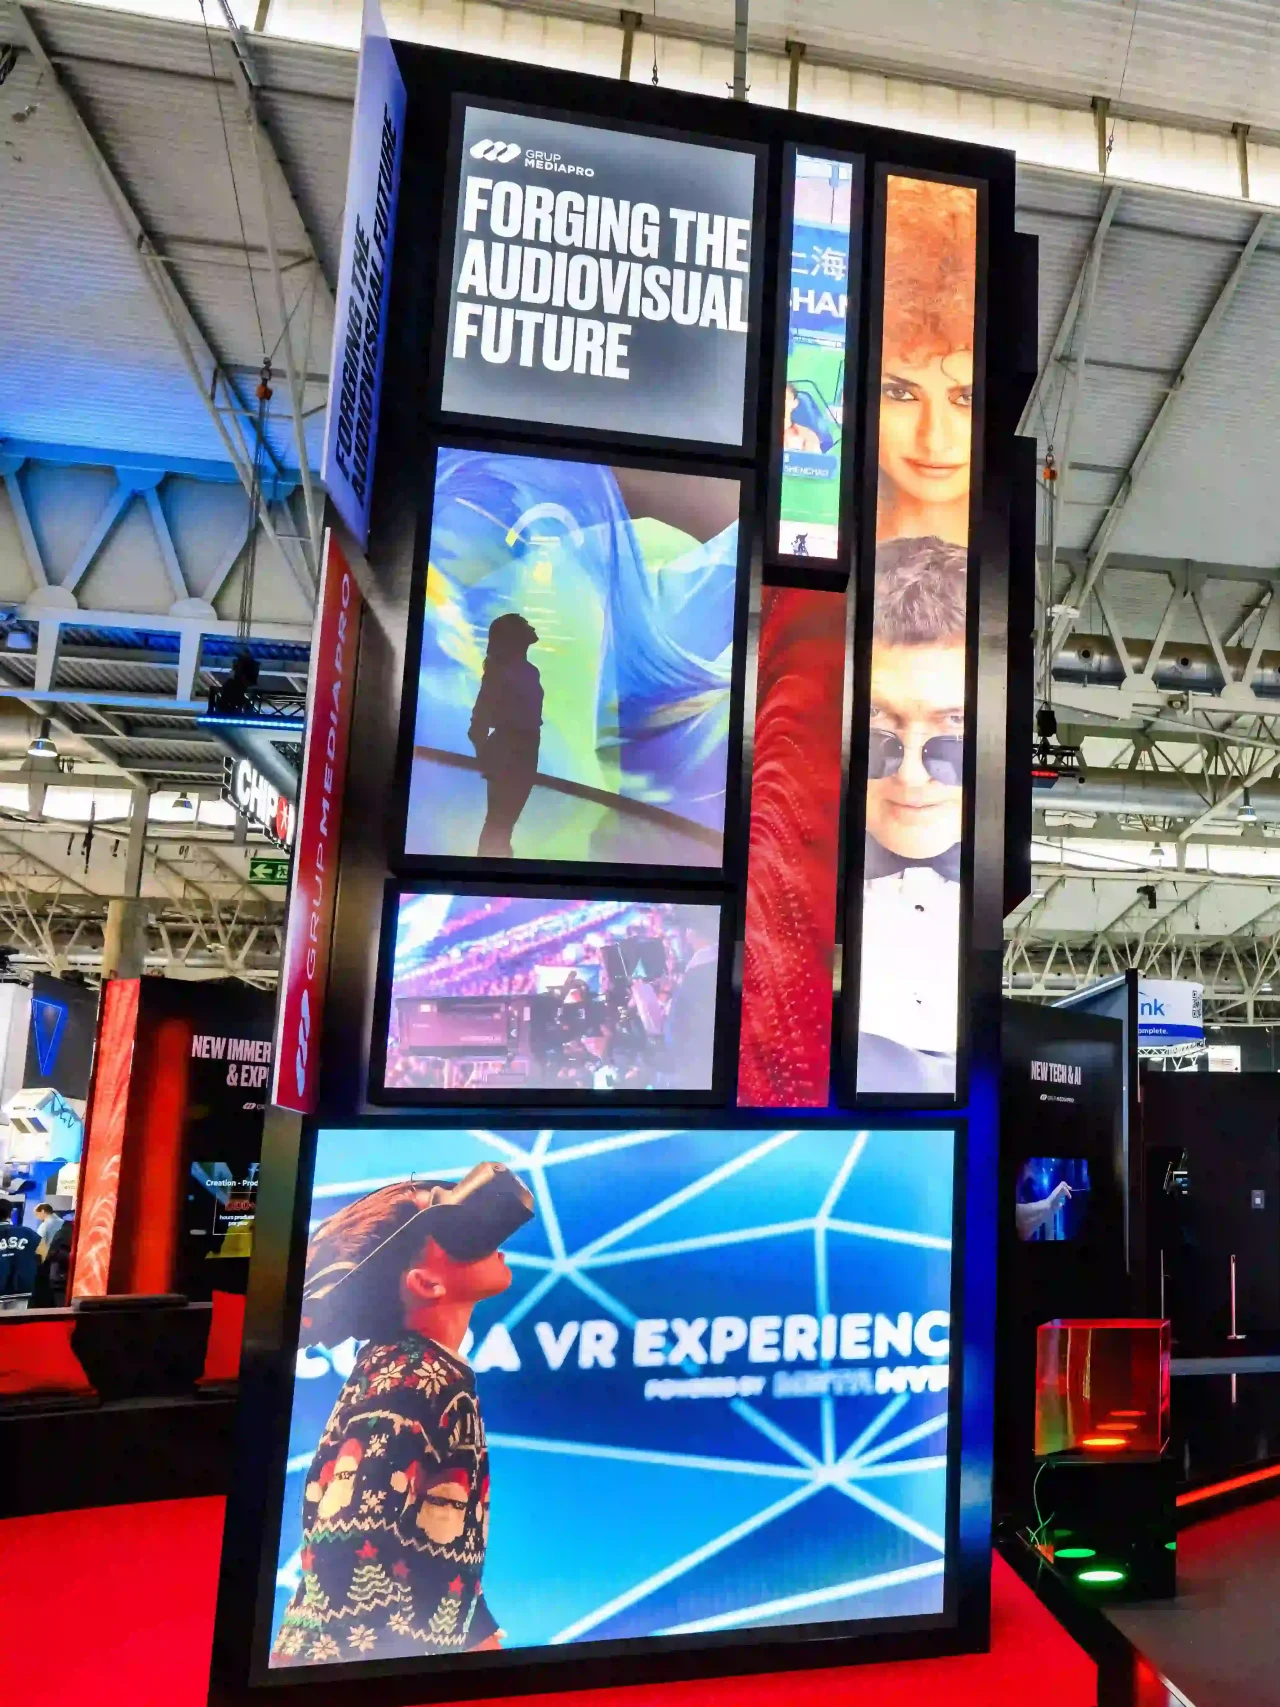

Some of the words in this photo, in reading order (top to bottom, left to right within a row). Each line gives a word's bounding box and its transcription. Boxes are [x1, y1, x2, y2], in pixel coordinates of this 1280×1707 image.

[524, 158, 595, 178] MEDIAPRO
[525, 149, 562, 163] GRUP
[463, 175, 660, 259] FORGING
[669, 207, 750, 272] THE
[349, 257, 386, 506] AUDIOVISUAL
[372, 101, 397, 257] FUTURE
[456, 238, 749, 332] AUDIOVISUAL
[335, 291, 364, 482] FORGING
[350, 213, 371, 299] THE
[452, 301, 632, 380] FUTURE
[191, 1034, 227, 1060] NEW
[226, 1063, 238, 1087] &
[1031, 1060, 1048, 1081] NEW
[1049, 1062, 1067, 1084] TECH
[1068, 1065, 1073, 1085] &
[1074, 1066, 1082, 1086] AI
[205, 1179, 236, 1187] Creation
[534, 1320, 619, 1371] VR
[633, 1310, 950, 1368] EXPERIENC
